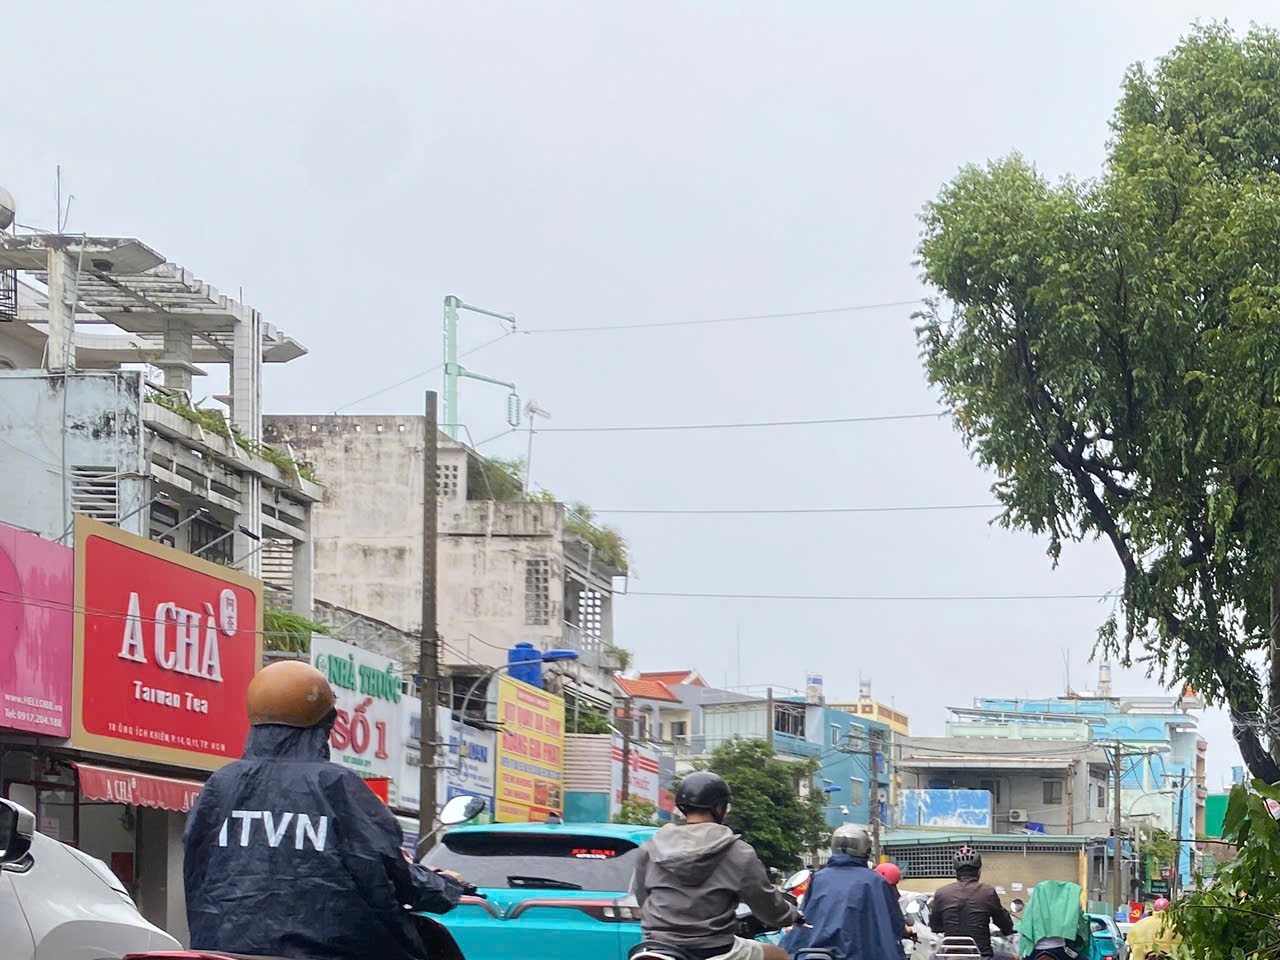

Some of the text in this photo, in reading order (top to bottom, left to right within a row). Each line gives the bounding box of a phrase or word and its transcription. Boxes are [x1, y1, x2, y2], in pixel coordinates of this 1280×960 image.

[118, 592, 223, 682] A CHÀ
[133, 680, 208, 714] Taiwan Tea
[328, 654, 402, 704] NHÀ THUỐC
[329, 697, 373, 755] SỐ
[375, 721, 389, 760] 1
[106, 779, 114, 799] A
